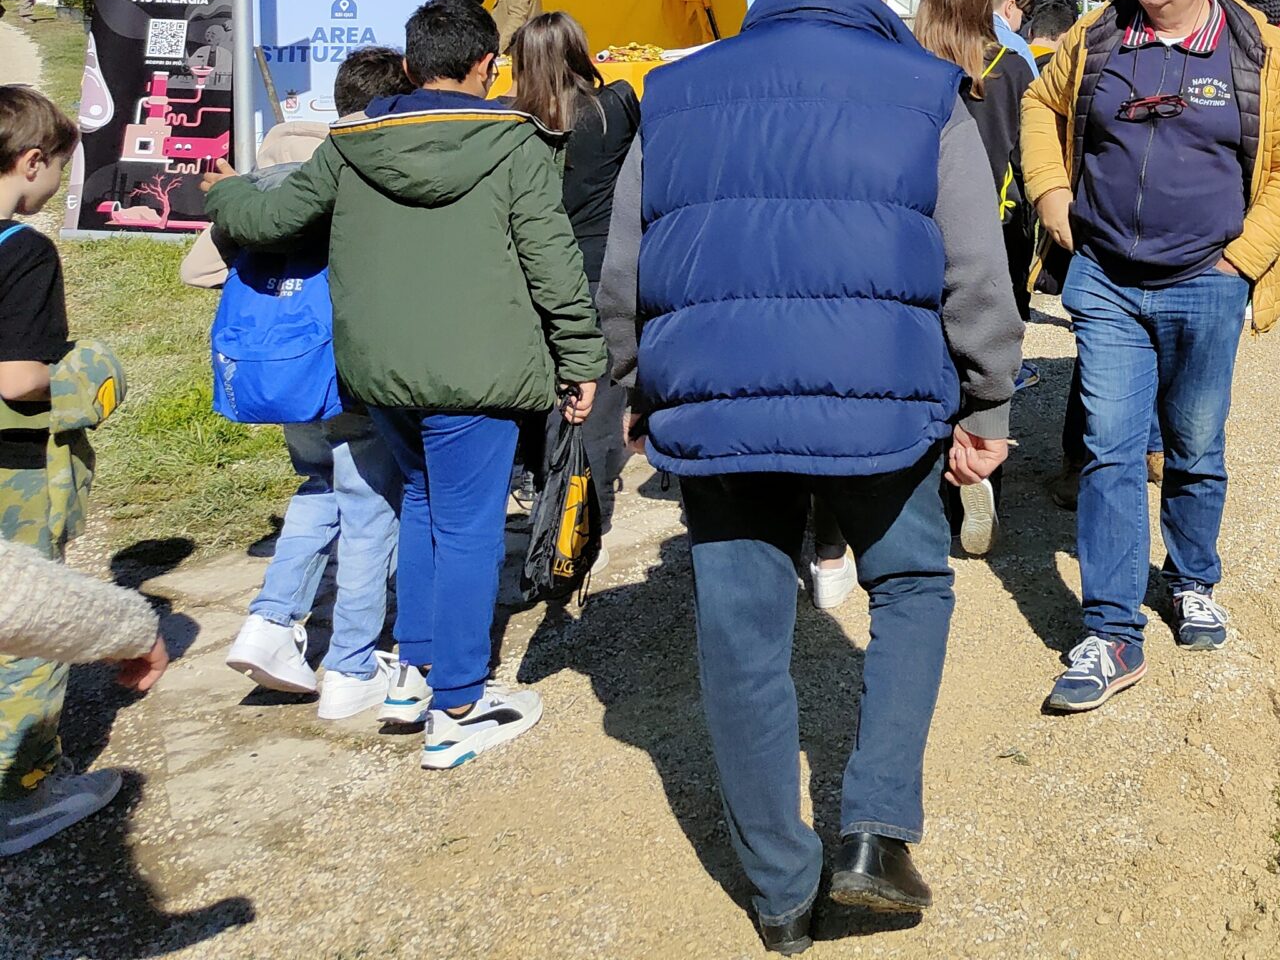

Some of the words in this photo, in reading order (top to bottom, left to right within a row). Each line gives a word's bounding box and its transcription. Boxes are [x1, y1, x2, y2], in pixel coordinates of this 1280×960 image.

[310, 27, 377, 44] AREA
[1192, 77, 1213, 87] NAVY
[1212, 78, 1229, 92] SAIL
[1190, 95, 1226, 107] YACHTING
